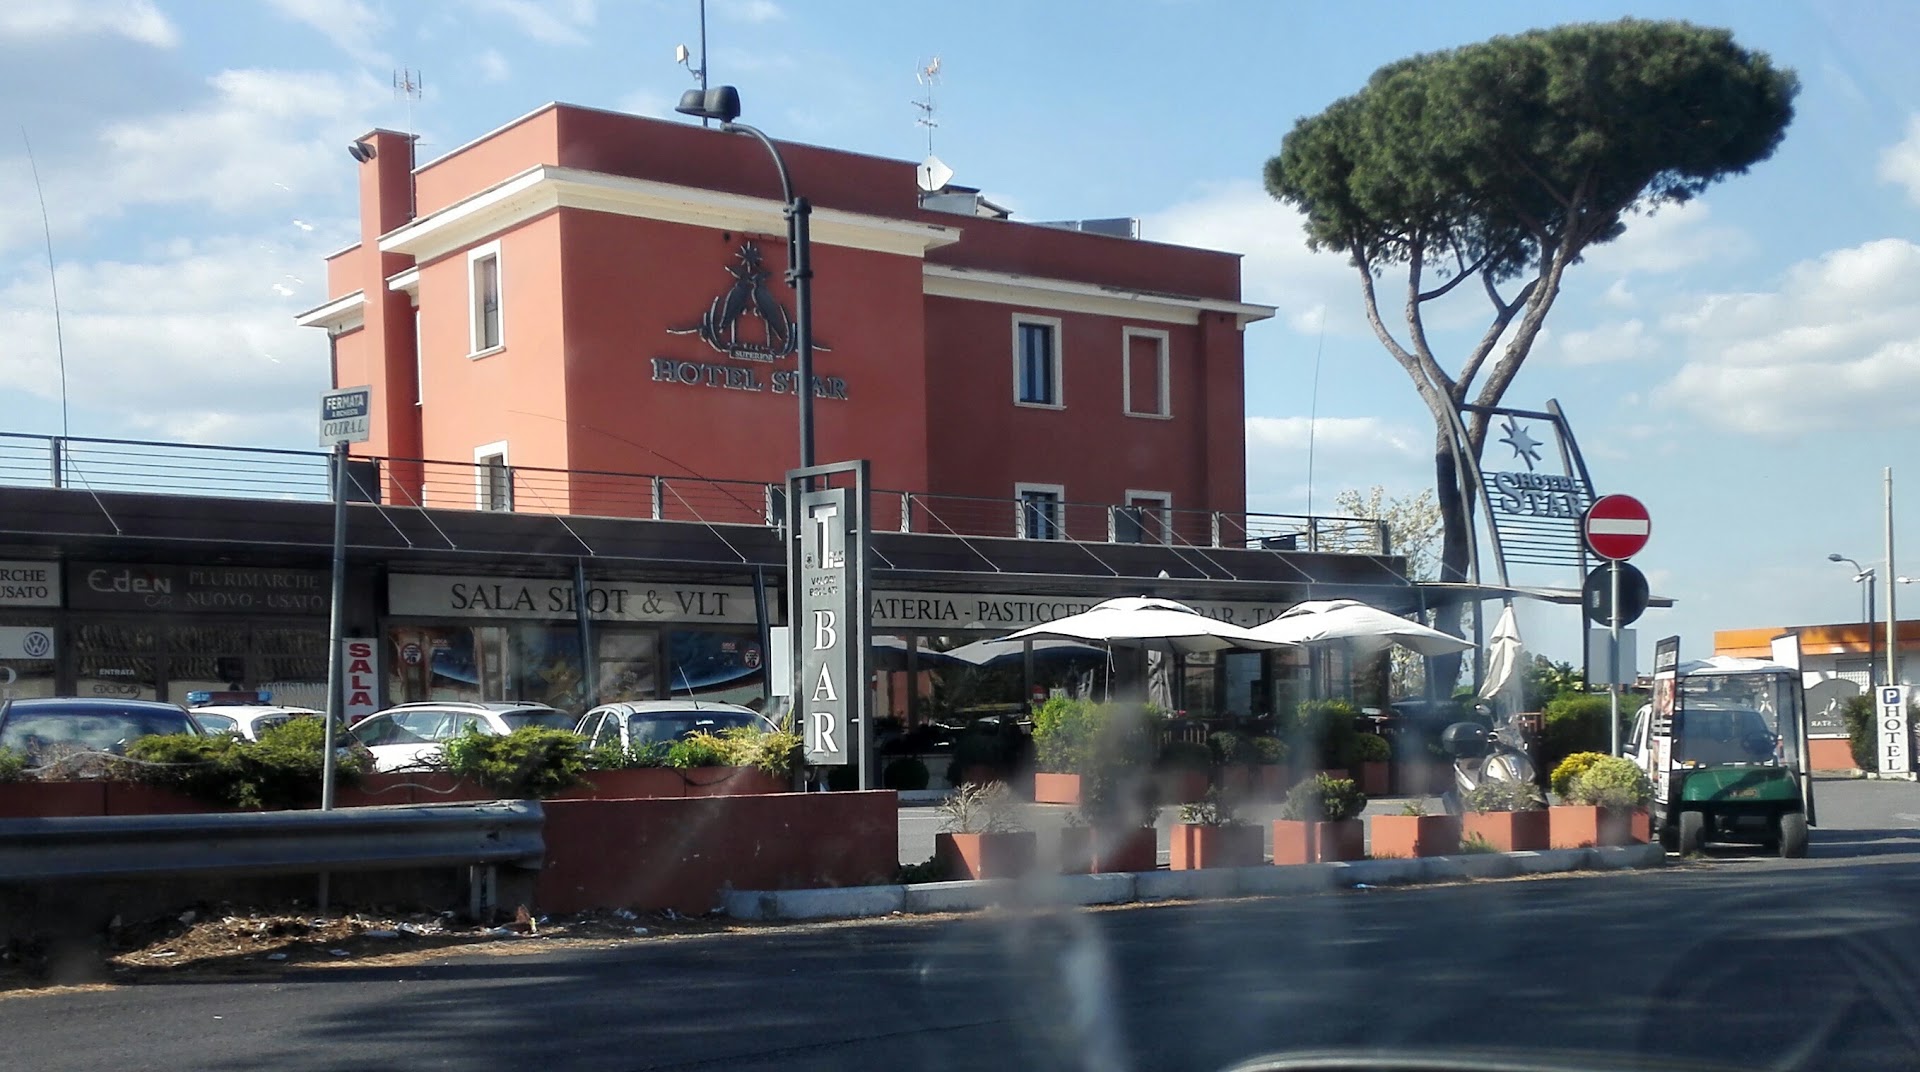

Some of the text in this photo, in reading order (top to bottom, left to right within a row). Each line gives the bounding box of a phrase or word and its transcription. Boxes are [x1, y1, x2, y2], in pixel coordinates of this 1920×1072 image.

[735, 350, 774, 362] SUPERIOR
[651, 358, 848, 400] HOTEL STAR
[326, 393, 365, 410] FERMATA
[1516, 473, 1581, 492] HOTEL
[1496, 471, 1583, 518] STAR
[0, 569, 46, 581] RCHE
[189, 570, 321, 589] PLURIMARCHE
[186, 592, 252, 608] NUOVO
[267, 594, 324, 609] USATO
[450, 583, 729, 617] SALA SLOT & VLT
[871, 598, 959, 621] ATERIA
[98, 668, 136, 676] ENTRATA
[348, 643, 373, 706] SALA
[812, 609, 839, 754] BAR
[1884, 706, 1901, 770] HOTEL
